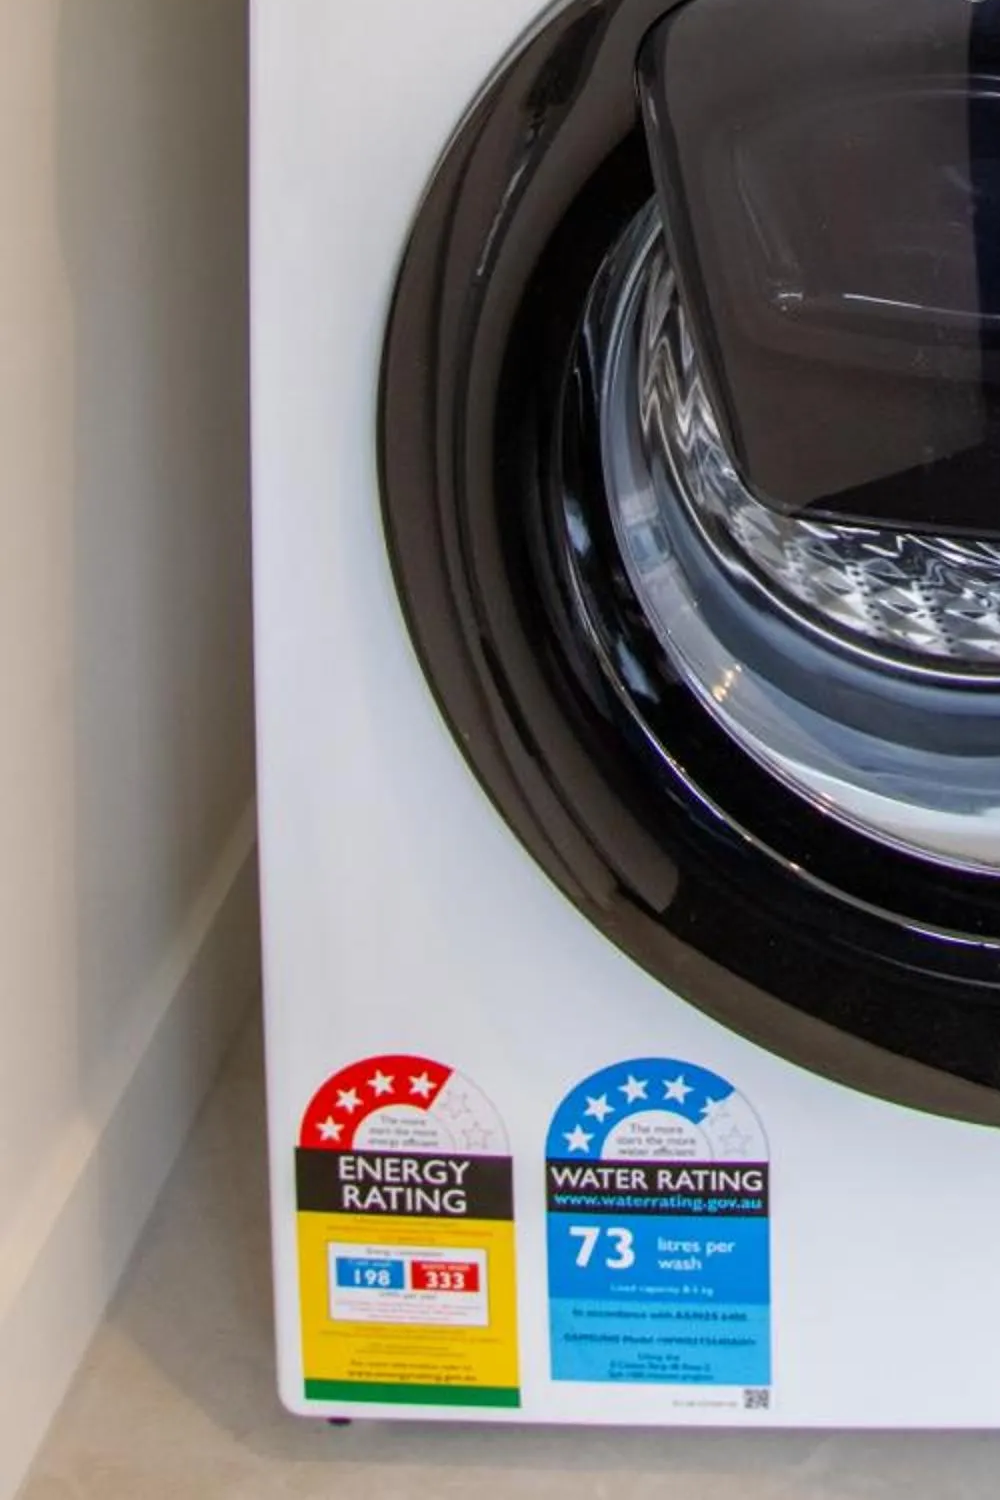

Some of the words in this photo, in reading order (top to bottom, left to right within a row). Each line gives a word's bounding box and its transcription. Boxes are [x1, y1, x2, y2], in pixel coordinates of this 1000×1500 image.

[631, 1124, 650, 1133] The
[654, 1125, 683, 1134] more
[645, 1136, 664, 1145] the
[667, 1138, 696, 1146] more
[338, 1155, 470, 1184] ENERGY
[551, 1167, 649, 1190] WATER
[657, 1169, 763, 1191] RATING
[343, 1186, 467, 1213] RATING
[554, 1194, 762, 1212] www.waterrating.gov.au
[568, 1225, 636, 1269] 73
[657, 1236, 701, 1252] litres
[706, 1241, 736, 1256] per
[657, 1256, 702, 1271] wash
[354, 1269, 392, 1285] 198
[426, 1272, 465, 1289] 333
